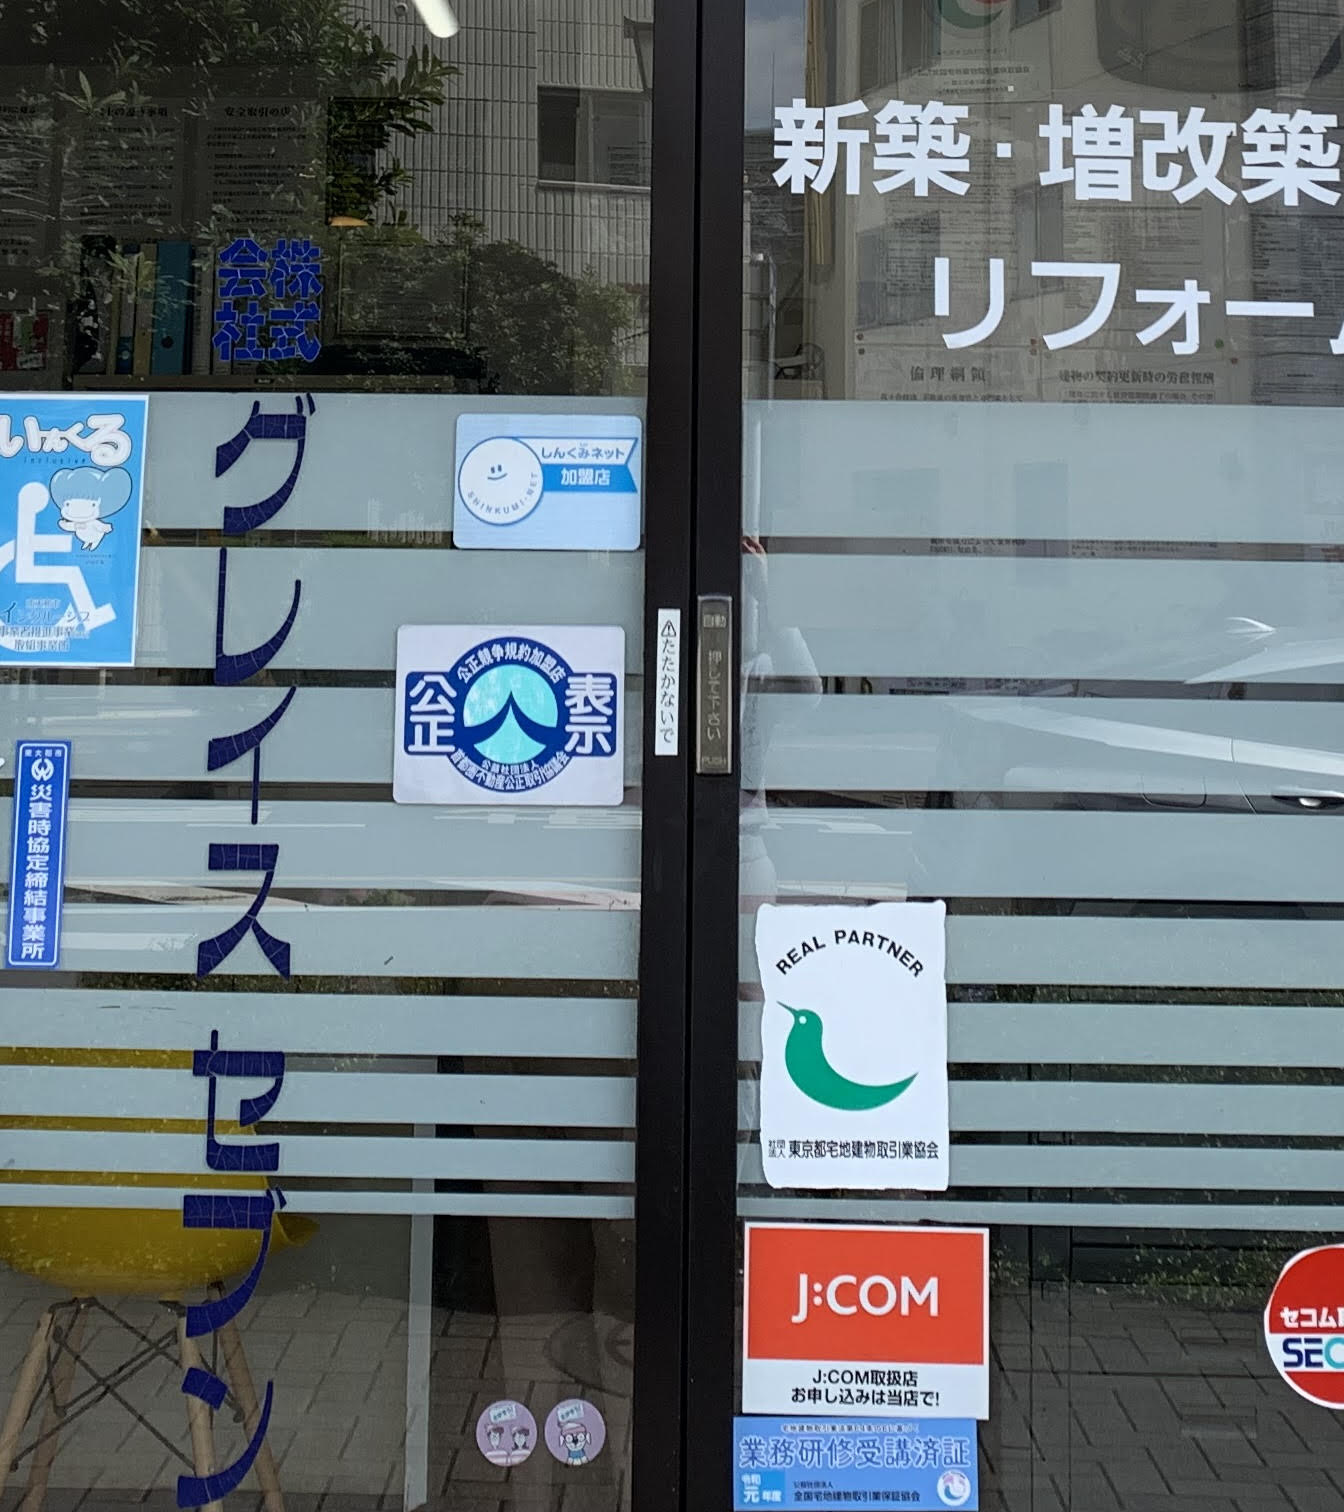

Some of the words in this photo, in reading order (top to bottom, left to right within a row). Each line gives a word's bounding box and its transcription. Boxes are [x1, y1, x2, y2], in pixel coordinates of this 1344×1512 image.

[772, 97, 1343, 207] 新築・増改築
[541, 445, 625, 461] しんくみネット
[560, 467, 611, 487] 加盟店
[197, 393, 316, 980] グレイス
[660, 638, 677, 744] たたかないで
[409, 674, 458, 754] 公正
[564, 674, 615, 754] 表示
[21, 784, 54, 961] 災害時協定締結事業所
[775, 933, 826, 977] REAL
[834, 928, 925, 978] PARTNER
[788, 1138, 940, 1161] 東京都宅地建物取引業協会
[177, 1029, 288, 1510] セブン
[791, 1273, 940, 1324] J:COM
[790, 1387, 940, 1407] お申し込みは当店で!
[812, 1368, 919, 1388] J:COM取扱店
[738, 1435, 972, 1469] 業務研修受講済証
